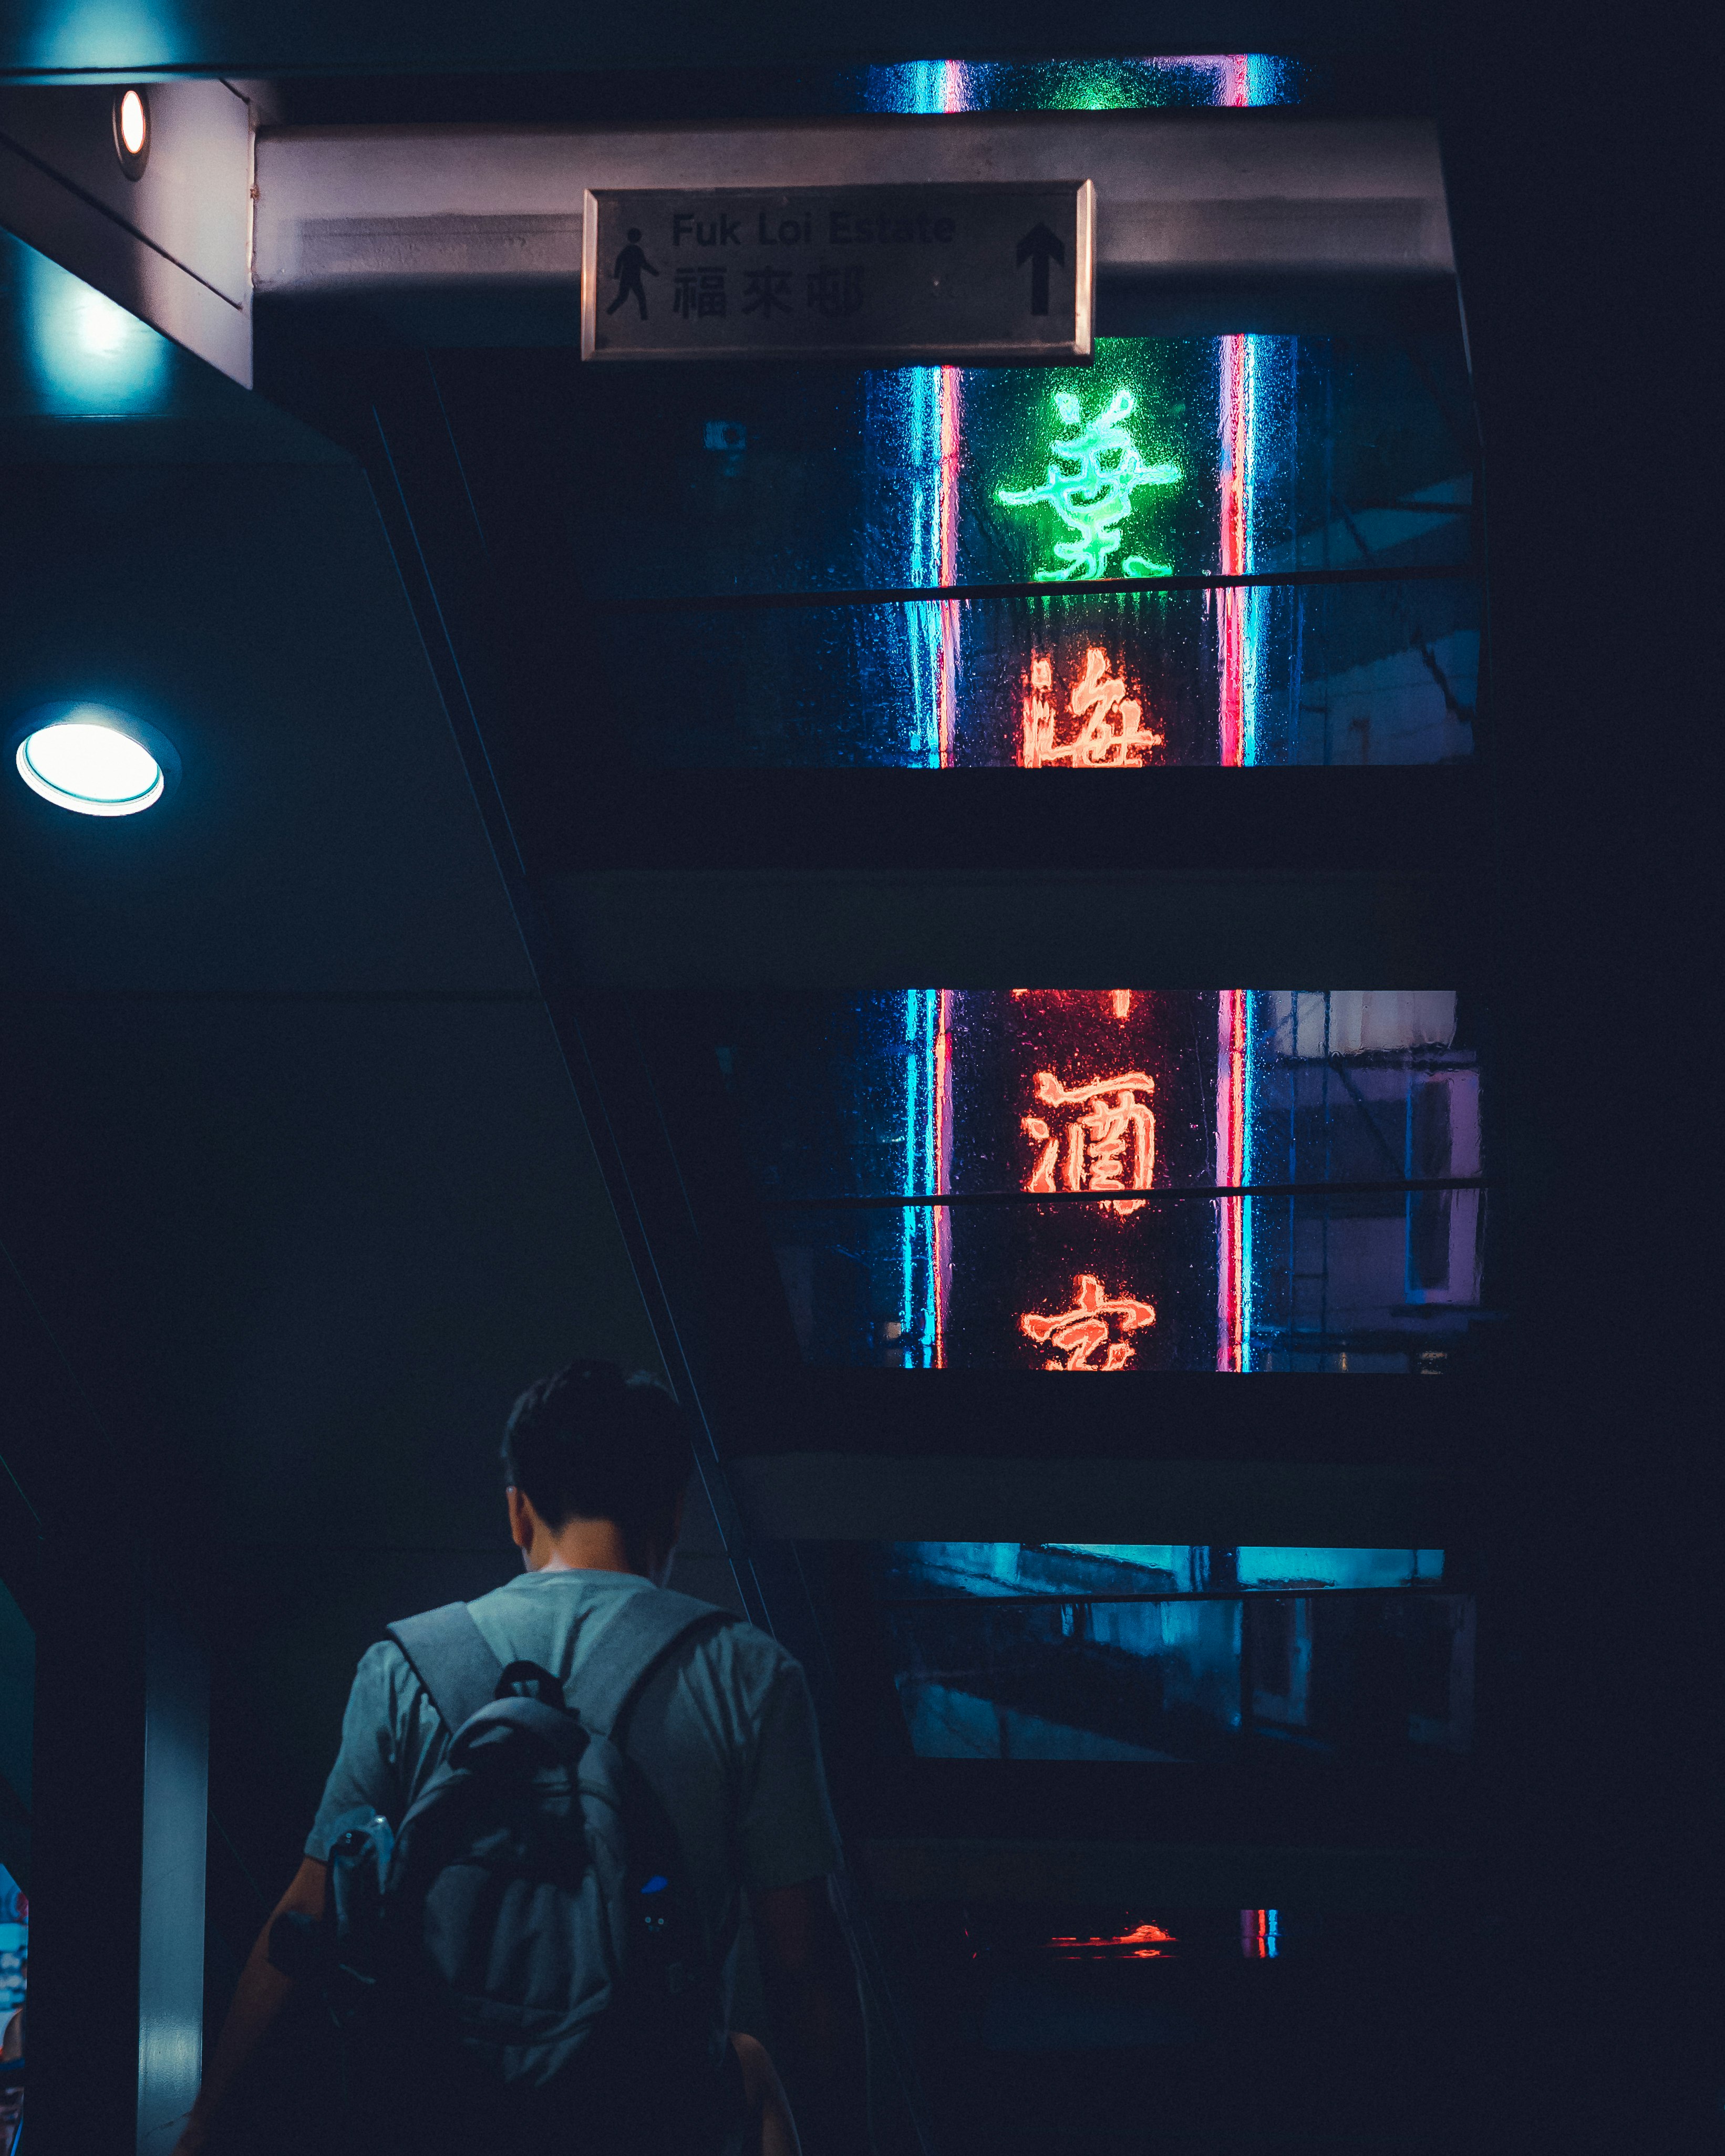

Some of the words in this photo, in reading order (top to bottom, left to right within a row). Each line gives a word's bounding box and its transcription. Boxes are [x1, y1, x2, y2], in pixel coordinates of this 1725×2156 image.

[673, 213, 741, 246] Fuk
[758, 212, 811, 245] Loi
[828, 211, 956, 244] Estate
[673, 264, 864, 319] 福來邨
